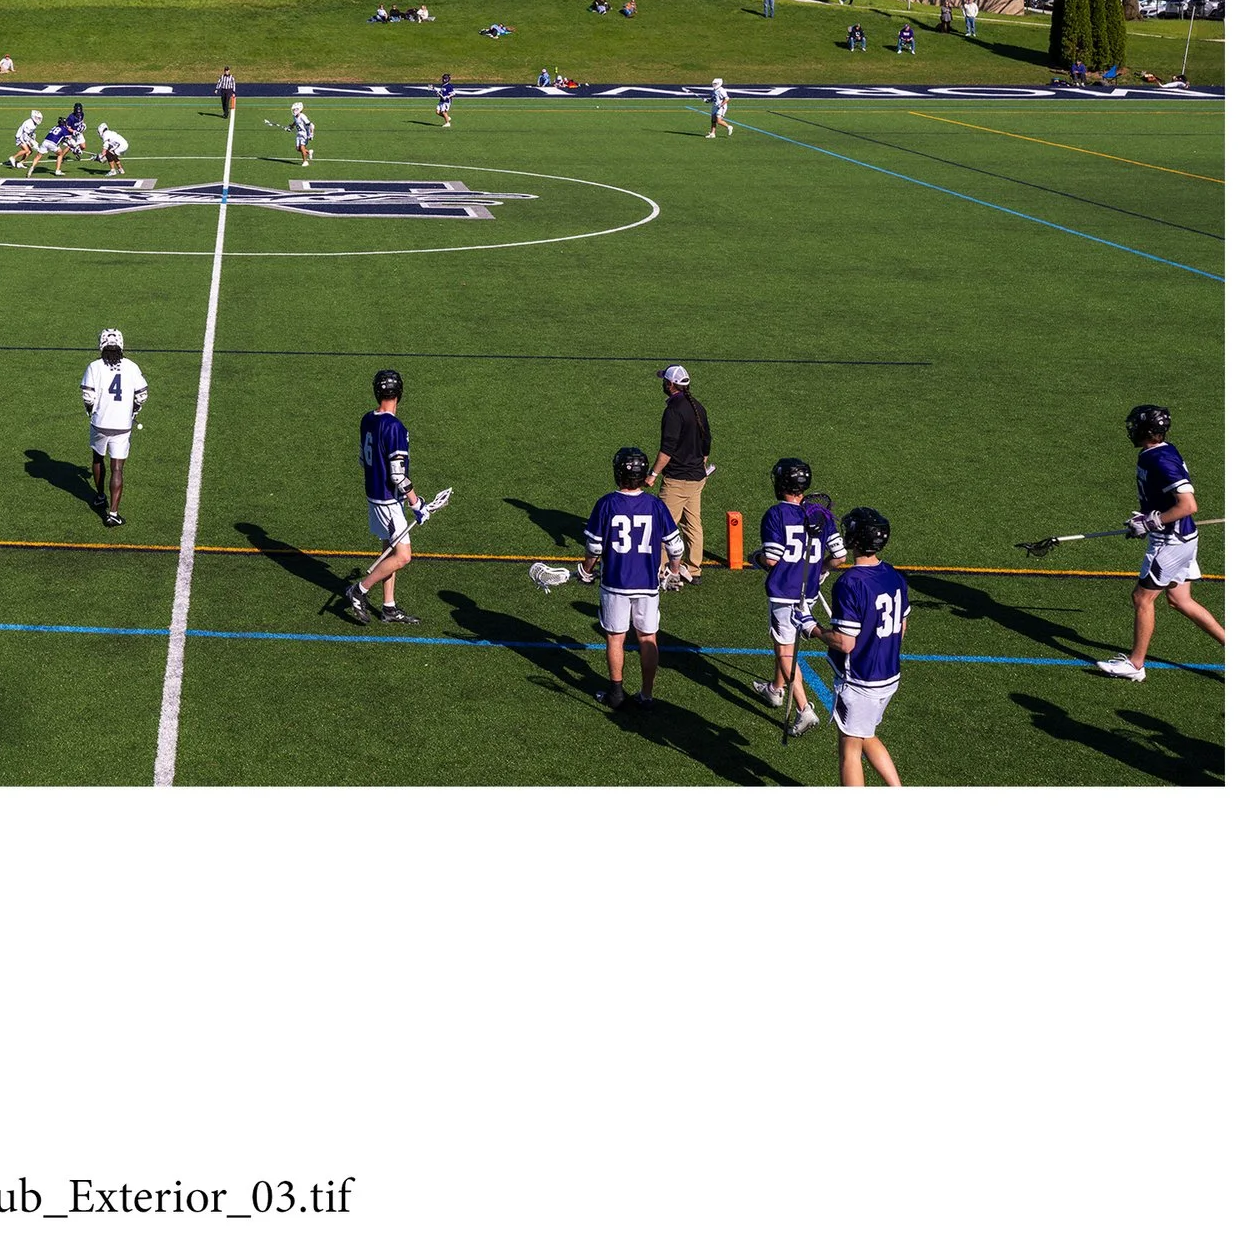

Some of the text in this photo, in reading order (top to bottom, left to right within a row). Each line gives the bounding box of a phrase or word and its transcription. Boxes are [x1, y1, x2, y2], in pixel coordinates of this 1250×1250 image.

[108, 373, 122, 402] 4
[611, 514, 653, 554] 37
[875, 589, 903, 639] 31
